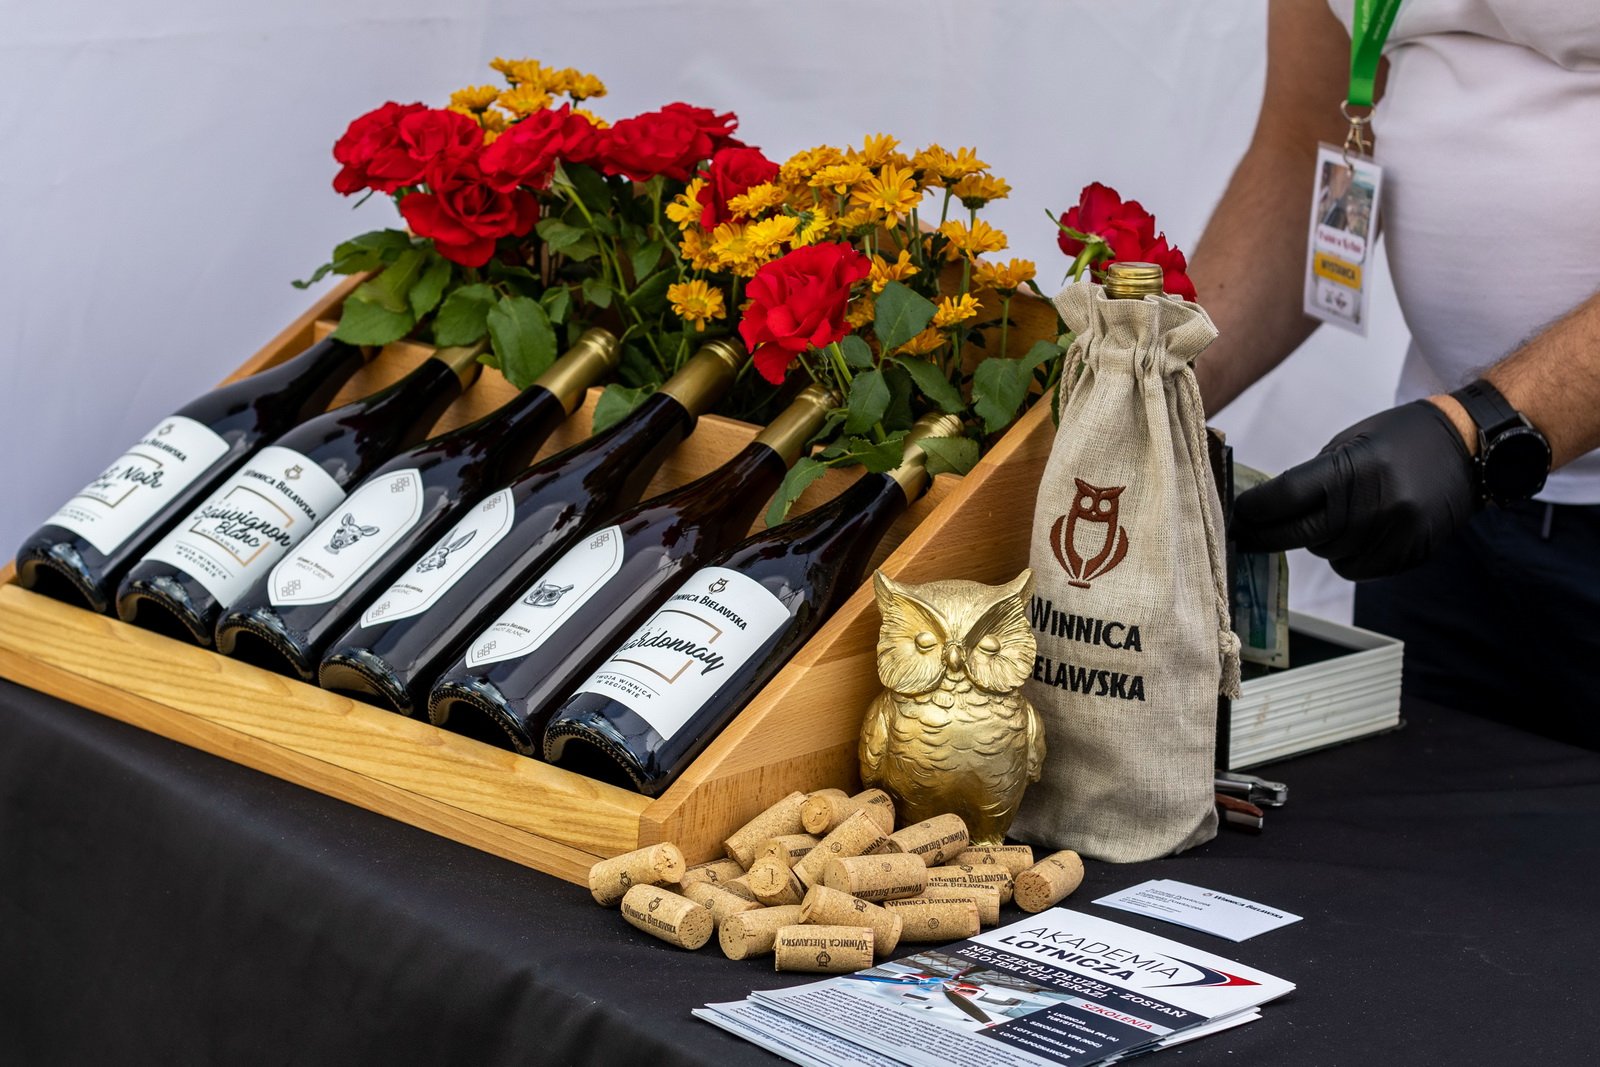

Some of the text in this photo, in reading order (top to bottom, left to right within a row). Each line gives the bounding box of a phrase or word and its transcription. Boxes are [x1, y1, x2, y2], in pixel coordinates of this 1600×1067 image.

[117, 465, 164, 489] Noir
[275, 480, 317, 521] BIELAWSKA
[194, 505, 291, 547] Sauvignon
[214, 520, 260, 548] Blanc
[198, 555, 228, 581] WINNICA
[699, 595, 748, 631] BIELAWSKA
[1031, 593, 1143, 652] WINNICA
[604, 680, 640, 699] REGIONIE
[618, 678, 652, 700] WINNICA
[1031, 654, 1146, 702] ELAWSKA
[941, 830, 968, 846] WINNICA
[991, 846, 1029, 854] WINNICA
[891, 883, 922, 894] WINNICA
[967, 873, 1009, 884] BIELAWSKA
[928, 897, 973, 905] BIELAWSKA
[623, 902, 677, 935] WINNICA BIELAWSKA
[781, 937, 869, 951] WINNICA BIELAWSKA
[998, 935, 1135, 981] LOTNICZA
[1020, 927, 1180, 980] AKADEMIA
[956, 948, 1016, 972] PILOTEM
[1053, 978, 1108, 999] TERAZ!
[967, 945, 997, 956] NIE
[996, 952, 1055, 977] CZEKAJ
[1050, 969, 1113, 993] DŁUŻEJ
[1119, 992, 1188, 1018] ZOSTAŃ
[1081, 1002, 1153, 1030] SZKOLENIA
